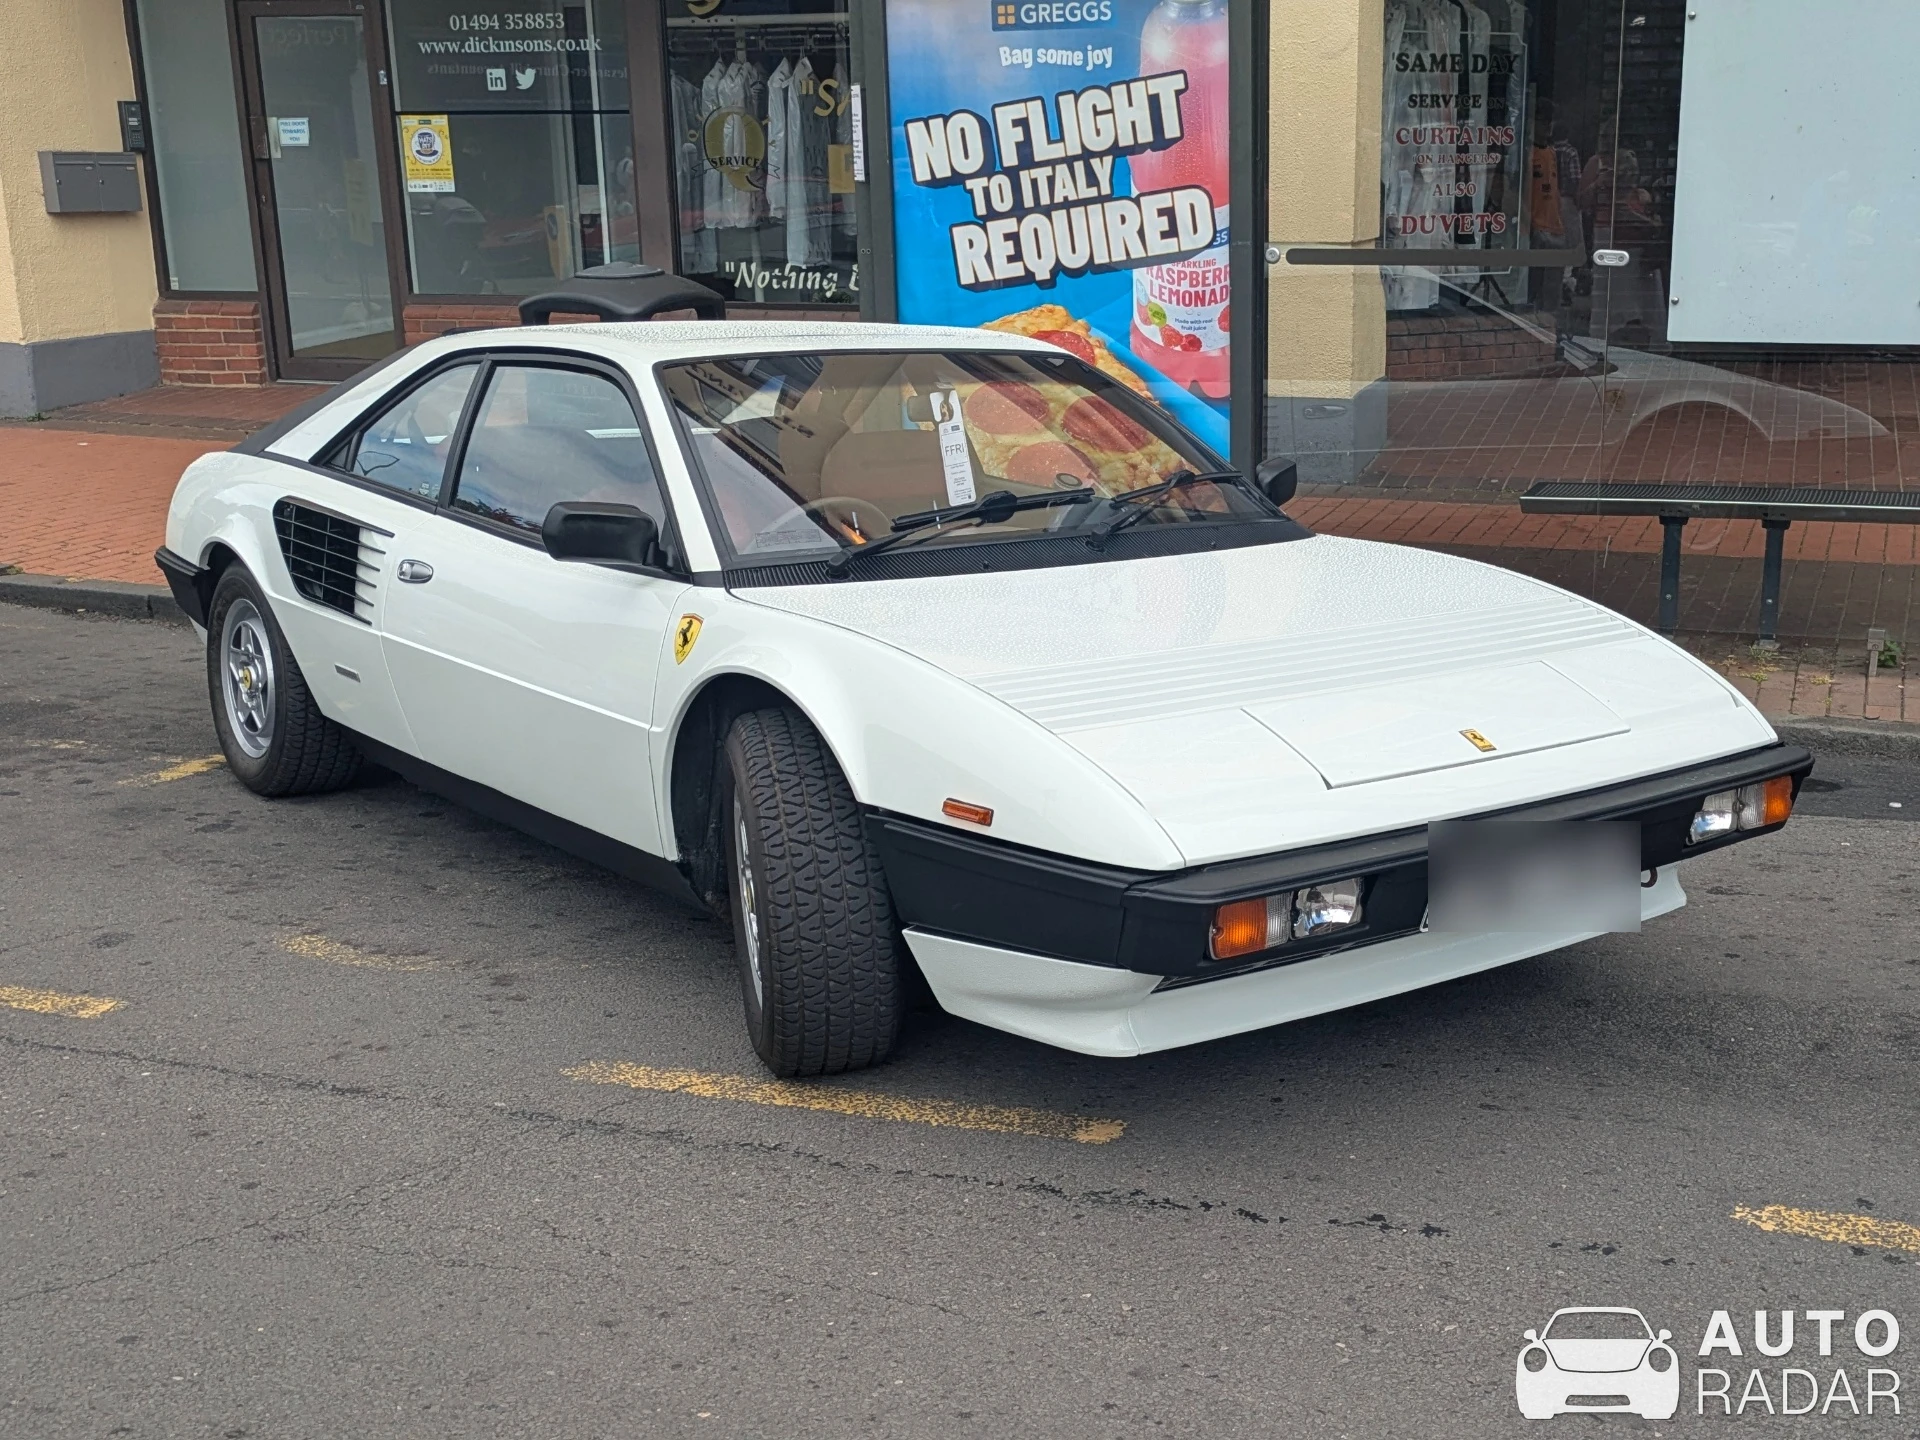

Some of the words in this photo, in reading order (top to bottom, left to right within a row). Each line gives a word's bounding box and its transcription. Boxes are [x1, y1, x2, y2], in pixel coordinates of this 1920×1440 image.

[450, 14, 500, 31] 01494
[504, 12, 565, 30] 358853
[1020, 1, 1112, 24] GREGGS
[418, 35, 602, 54] www.dickinsons.co.uk
[999, 46, 1033, 69] Bag
[1036, 48, 1084, 66] some
[1086, 44, 1113, 71] joy
[1470, 53, 1519, 73] DAY
[1407, 93, 1482, 109] SERVICE
[906, 111, 985, 183] NO
[994, 73, 1186, 168] FLIGHT
[1395, 126, 1515, 146] CURTAINS
[966, 173, 1013, 217] TO
[1019, 155, 1113, 209] ITALY
[1432, 182, 1477, 197] ALSO
[1400, 213, 1506, 235] DUVETS
[952, 187, 1215, 285] REQUIRED
